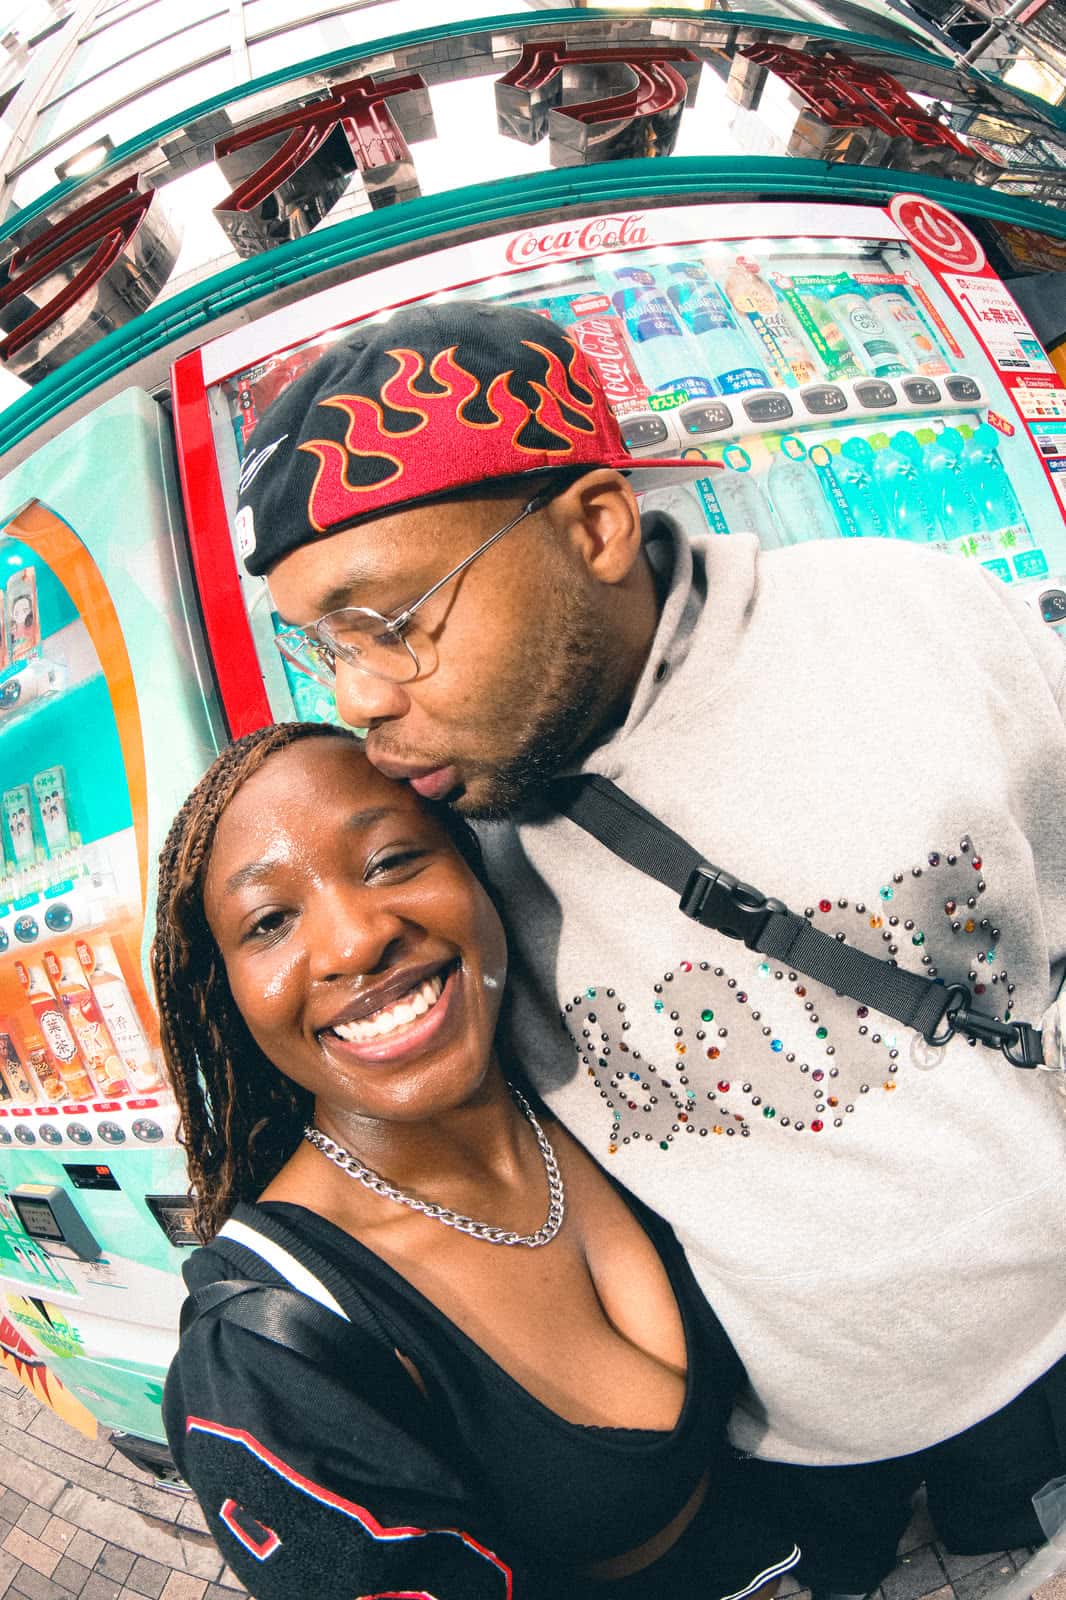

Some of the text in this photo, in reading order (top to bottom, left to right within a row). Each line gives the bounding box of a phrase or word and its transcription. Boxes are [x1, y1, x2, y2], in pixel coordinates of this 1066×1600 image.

[505, 214, 650, 266] Coca-Cola
[575, 318, 639, 402] Coca-Cola
[650, 393, 689, 411] オススメ!
